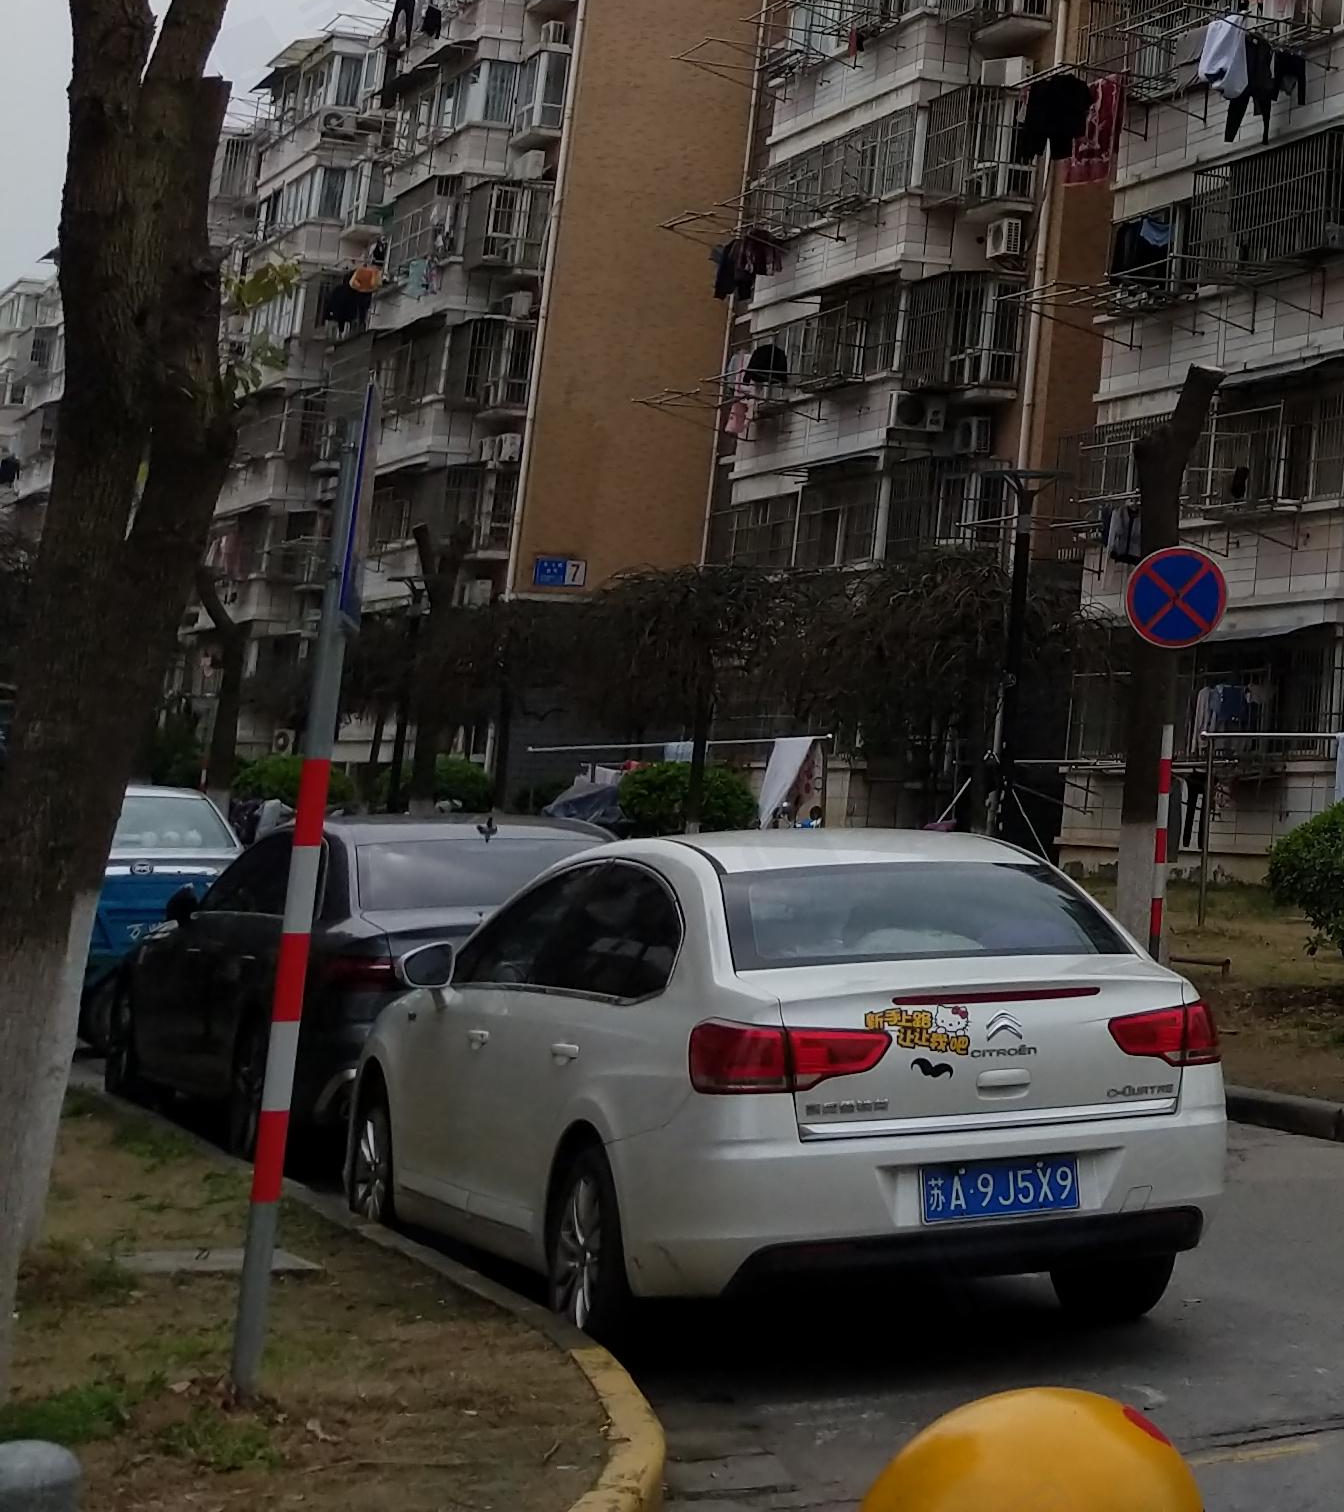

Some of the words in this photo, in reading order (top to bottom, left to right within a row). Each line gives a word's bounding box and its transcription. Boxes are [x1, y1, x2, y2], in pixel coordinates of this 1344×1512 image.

[570, 563, 581, 583] 7
[864, 1007, 934, 1030] 新手上路
[897, 1028, 971, 1056] 让让我吧
